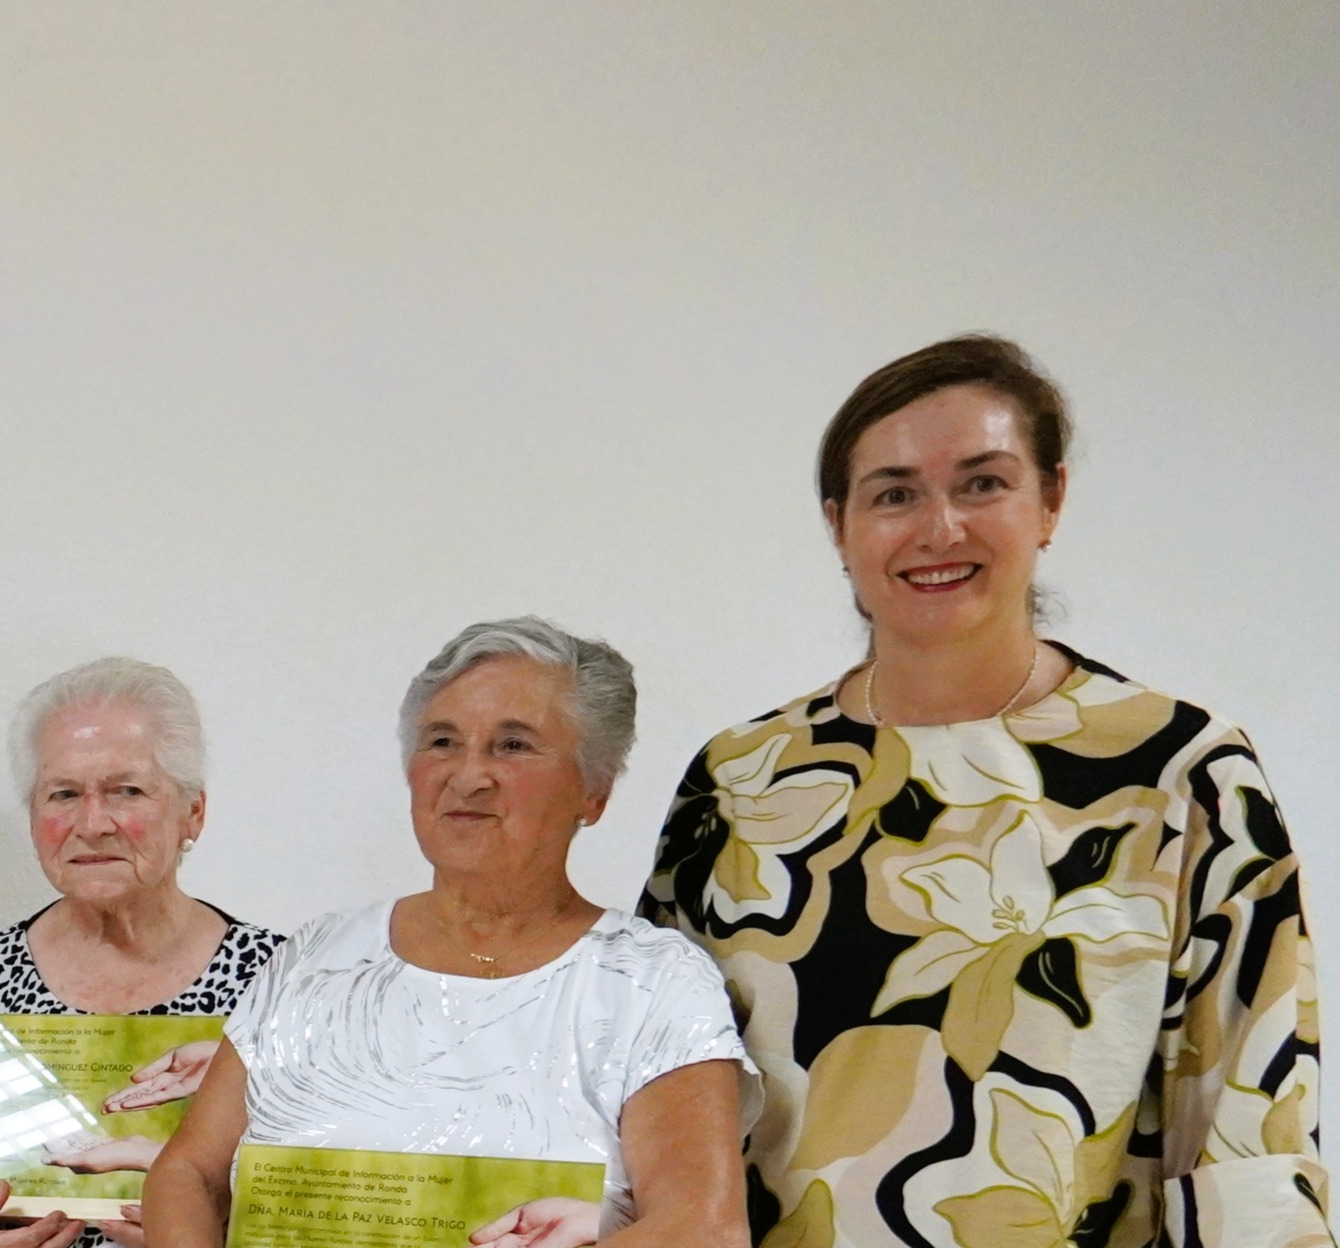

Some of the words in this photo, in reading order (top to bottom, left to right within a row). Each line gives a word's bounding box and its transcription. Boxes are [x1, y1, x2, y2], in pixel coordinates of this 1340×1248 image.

[253, 1162, 261, 1171] El
[263, 1162, 292, 1173] Centro
[294, 1164, 336, 1177] Municipal
[337, 1169, 350, 1177] de
[416, 1174, 425, 1182] la
[427, 1174, 453, 1184] Mujer
[252, 1175, 266, 1183] del
[300, 1178, 361, 1190] Ayuntamiento
[363, 1183, 375, 1191] de
[377, 1182, 407, 1193] Ronda
[250, 1186, 282, 1197] Otorga
[284, 1189, 293, 1197] el
[294, 1191, 332, 1200] presente
[334, 1194, 402, 1205] reconocimiento
[278, 1205, 314, 1218] MARÍA
[317, 1210, 331, 1220] DE
[334, 1211, 348, 1221] LA
[352, 1211, 372, 1223] PAZ
[376, 1213, 427, 1227] VELASCO
[430, 1216, 465, 1230] TRIGO
